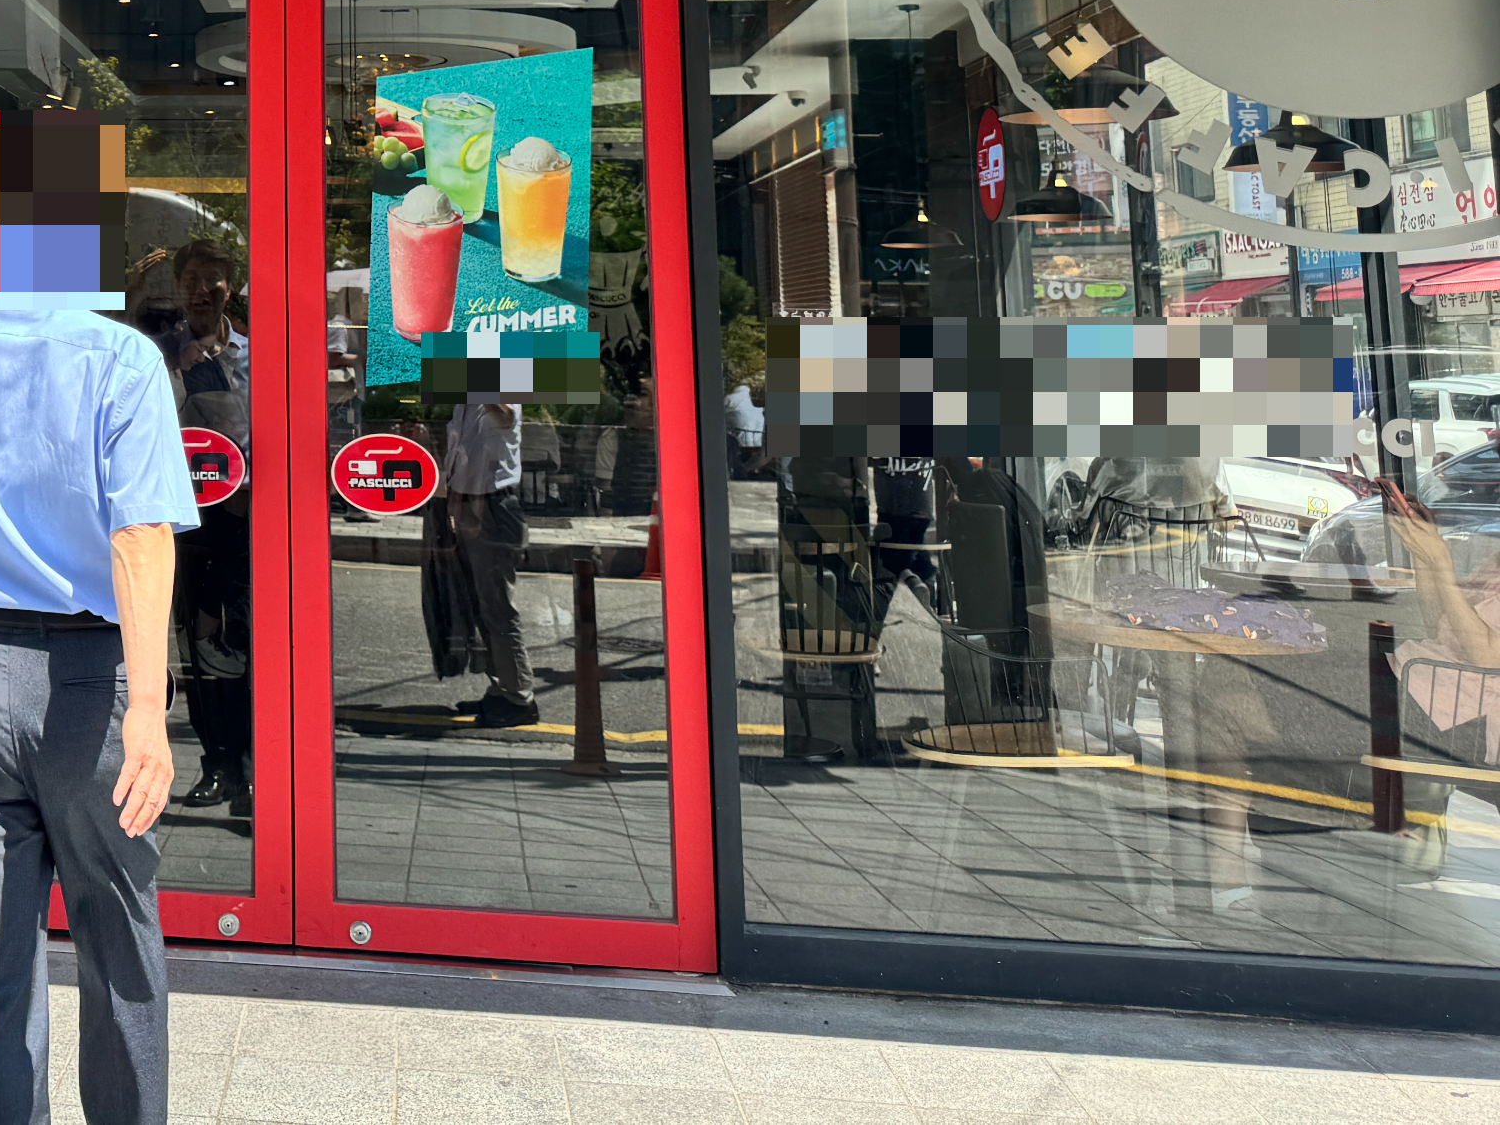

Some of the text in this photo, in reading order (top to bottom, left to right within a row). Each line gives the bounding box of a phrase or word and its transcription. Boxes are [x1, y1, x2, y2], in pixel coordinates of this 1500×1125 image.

[1047, 280, 1082, 300] CU
[465, 296, 520, 315] Let the
[465, 304, 577, 332] SUMMER
[348, 478, 412, 488] PASCUCCI
